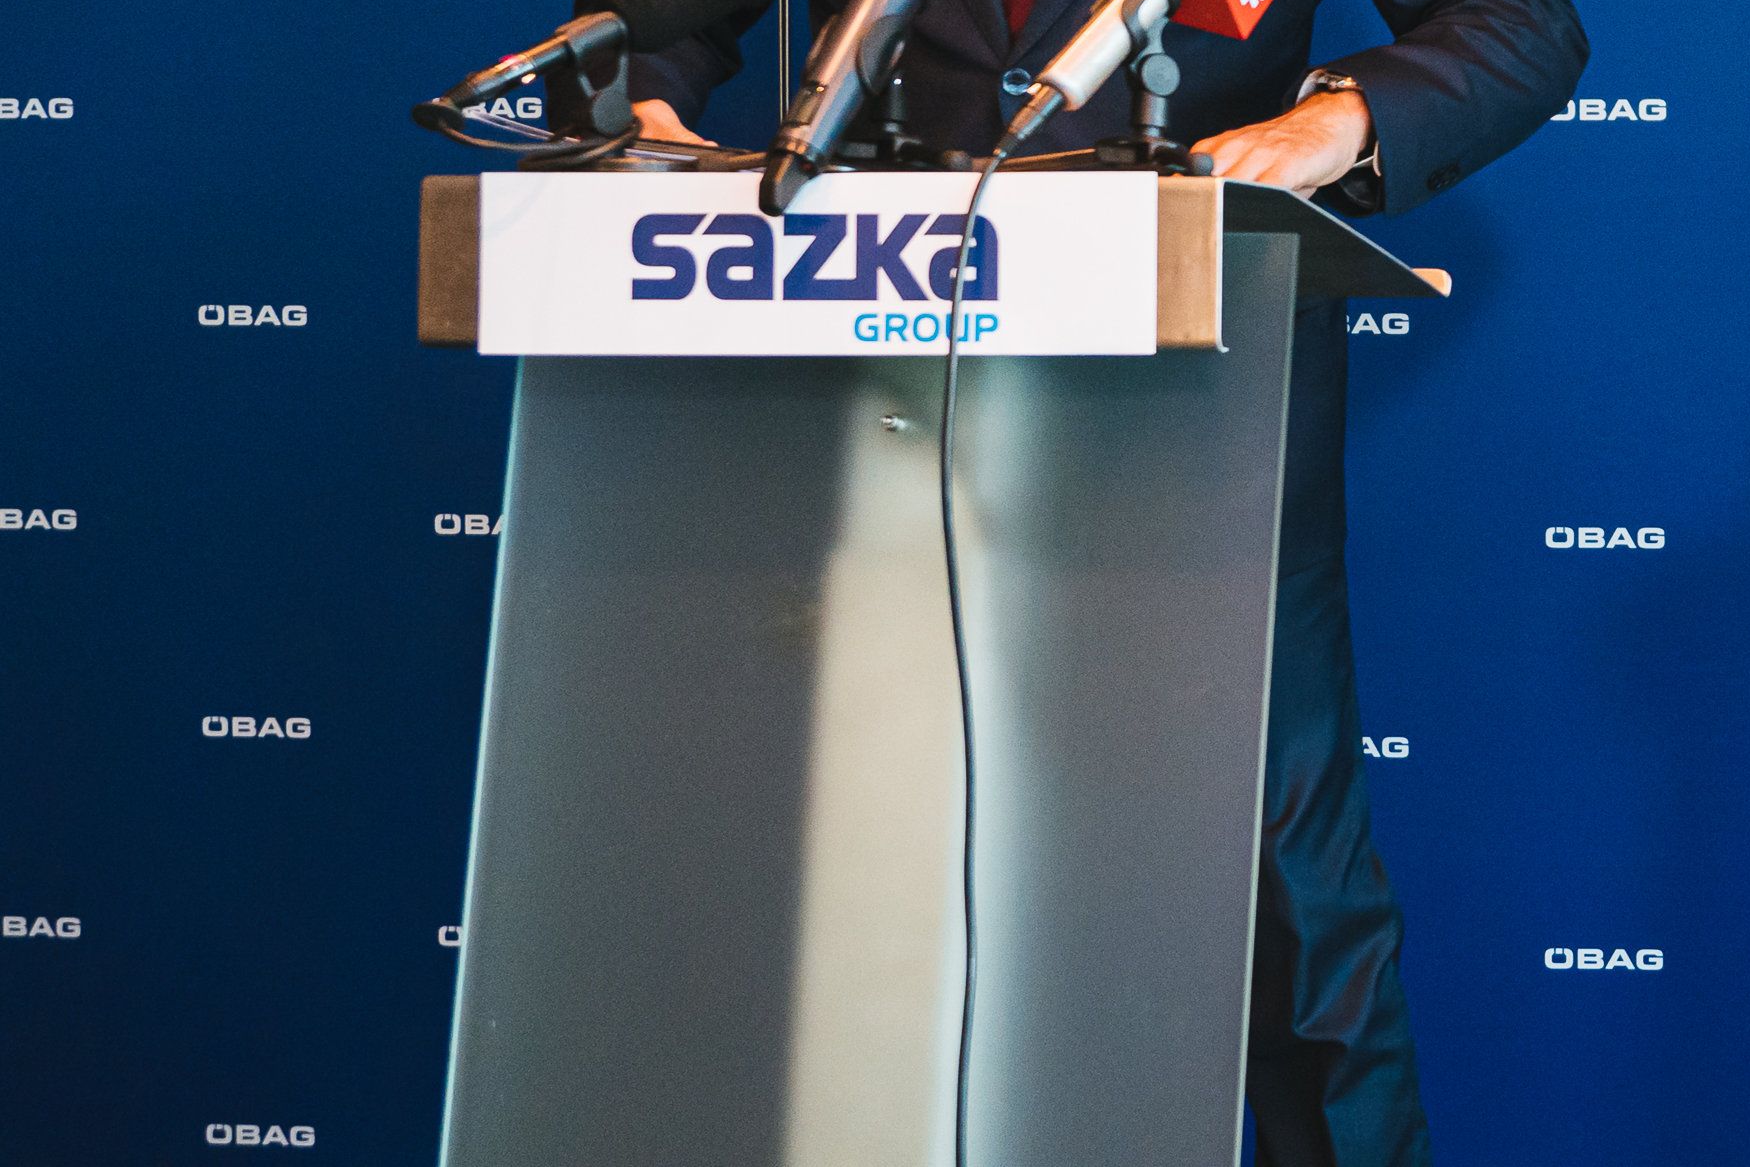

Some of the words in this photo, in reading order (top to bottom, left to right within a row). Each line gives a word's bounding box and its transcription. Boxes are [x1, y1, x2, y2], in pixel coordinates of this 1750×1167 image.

[0, 97, 74, 120] BAG
[1347, 313, 1409, 335] AG
[0, 509, 78, 531] BAG
[1362, 736, 1410, 758] AG
[2, 915, 82, 939] BAG
